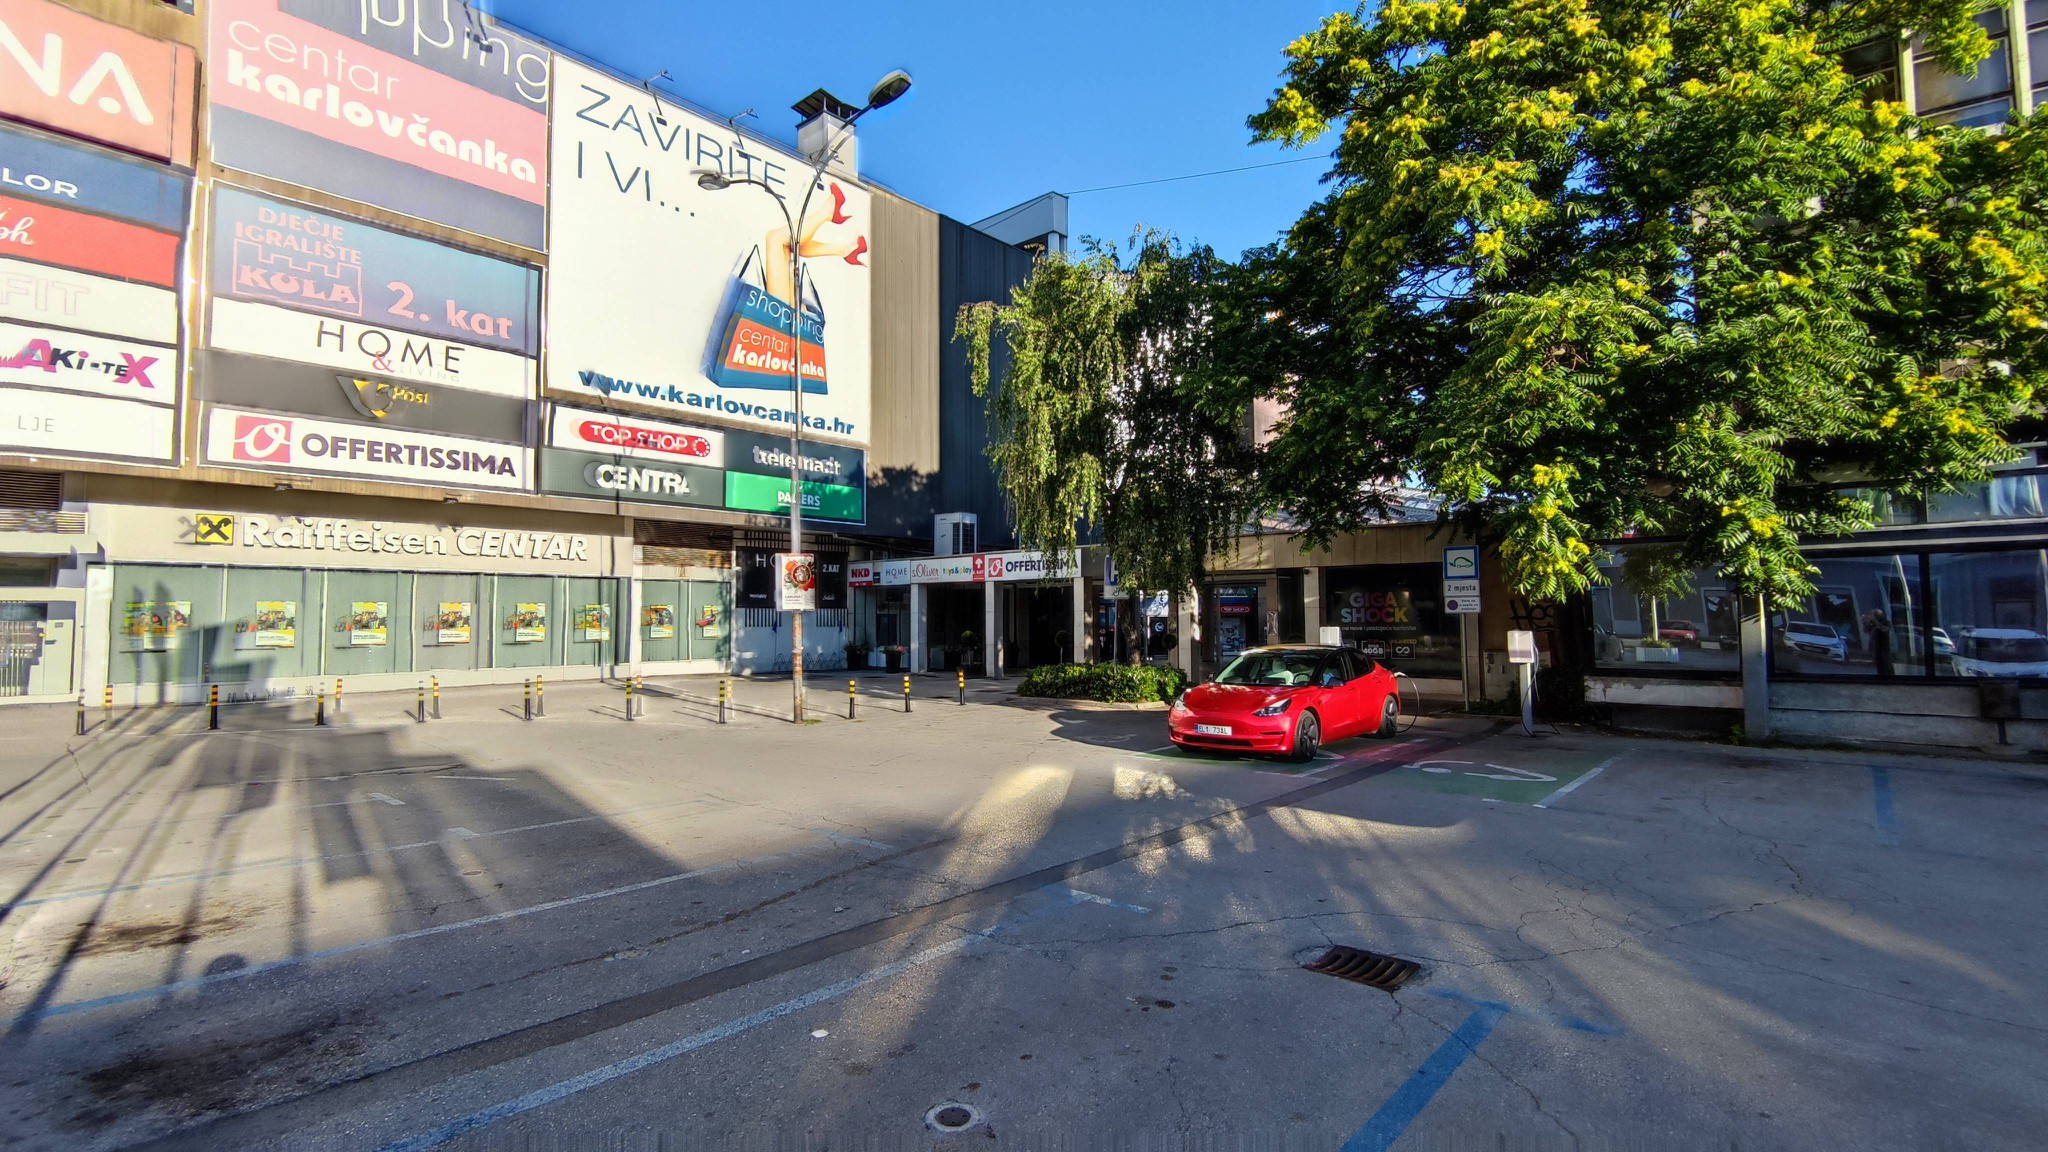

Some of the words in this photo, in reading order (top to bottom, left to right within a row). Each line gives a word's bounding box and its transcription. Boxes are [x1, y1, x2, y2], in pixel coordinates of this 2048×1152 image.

[228, 20, 400, 100] centar
[227, 47, 537, 184] karlovčanka
[575, 84, 786, 200] ZAVIRITE
[577, 141, 583, 178] I
[235, 221, 362, 266] IGRALIŠTE
[258, 206, 344, 242] DJEČJE
[237, 264, 357, 305] KULA
[386, 281, 431, 322] 2.
[446, 298, 514, 340] kat
[316, 320, 466, 374] HOME
[740, 327, 789, 354] centar
[301, 432, 517, 478] OFFERTISSIMA
[590, 424, 632, 444] TOP
[636, 431, 688, 450] SHOP
[242, 515, 447, 554] Raiffeisen
[455, 529, 588, 561] CENTAR
[851, 568, 870, 579] NKD
[1447, 584, 1452, 592] 2
[1453, 584, 1476, 593] mjesta
[1340, 607, 1409, 624] SHOCK
[1349, 591, 1398, 608] GIGA
